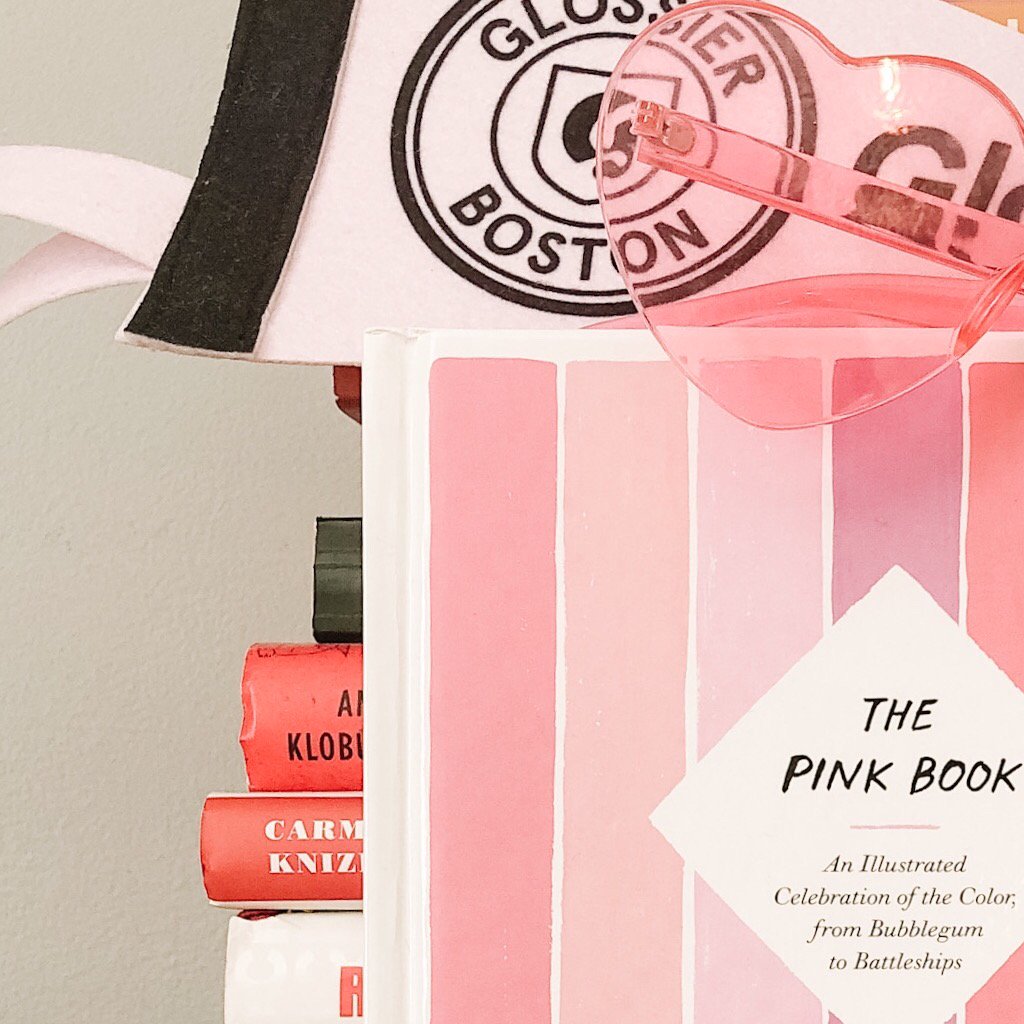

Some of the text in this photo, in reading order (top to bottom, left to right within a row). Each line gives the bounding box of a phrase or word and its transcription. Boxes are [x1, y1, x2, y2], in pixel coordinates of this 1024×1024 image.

[449, 184, 709, 281] BOSTON
[337, 689, 364, 717] A
[863, 697, 939, 733] THE
[782, 755, 1023, 796] PINK BOOK
[269, 853, 364, 874] KNIZ
[822, 854, 968, 874] An Illustrated
[774, 886, 1018, 911] Celebration of the Color,
[806, 918, 985, 944] from Bubblegum
[828, 952, 963, 977] to Battleships
